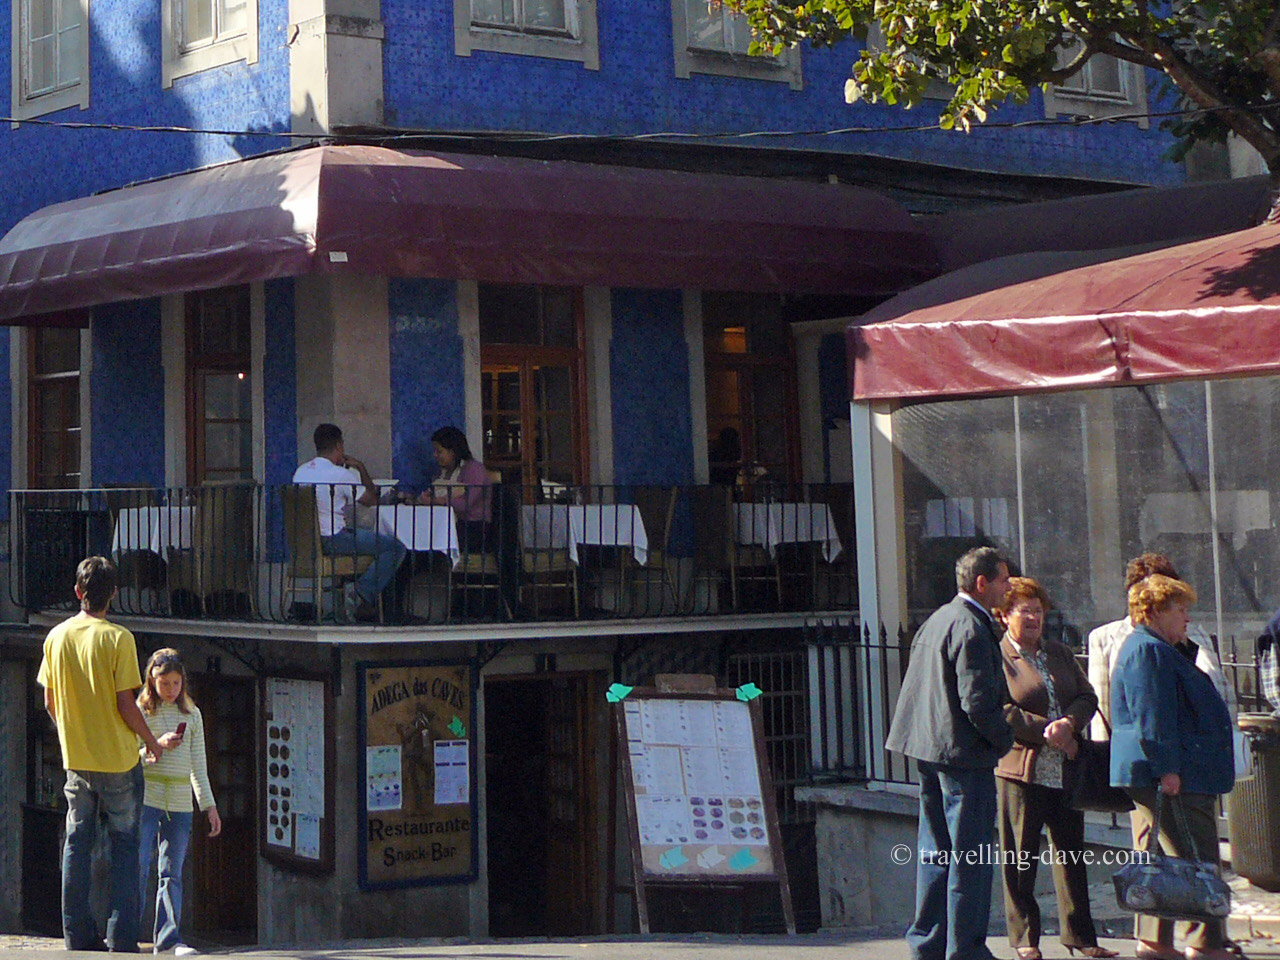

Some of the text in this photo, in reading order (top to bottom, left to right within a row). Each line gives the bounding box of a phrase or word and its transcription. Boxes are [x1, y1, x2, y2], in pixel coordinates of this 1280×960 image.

[371, 680, 411, 715] ADEGA
[368, 819, 471, 841] Restaurante
[383, 842, 457, 867] Snack Bar
